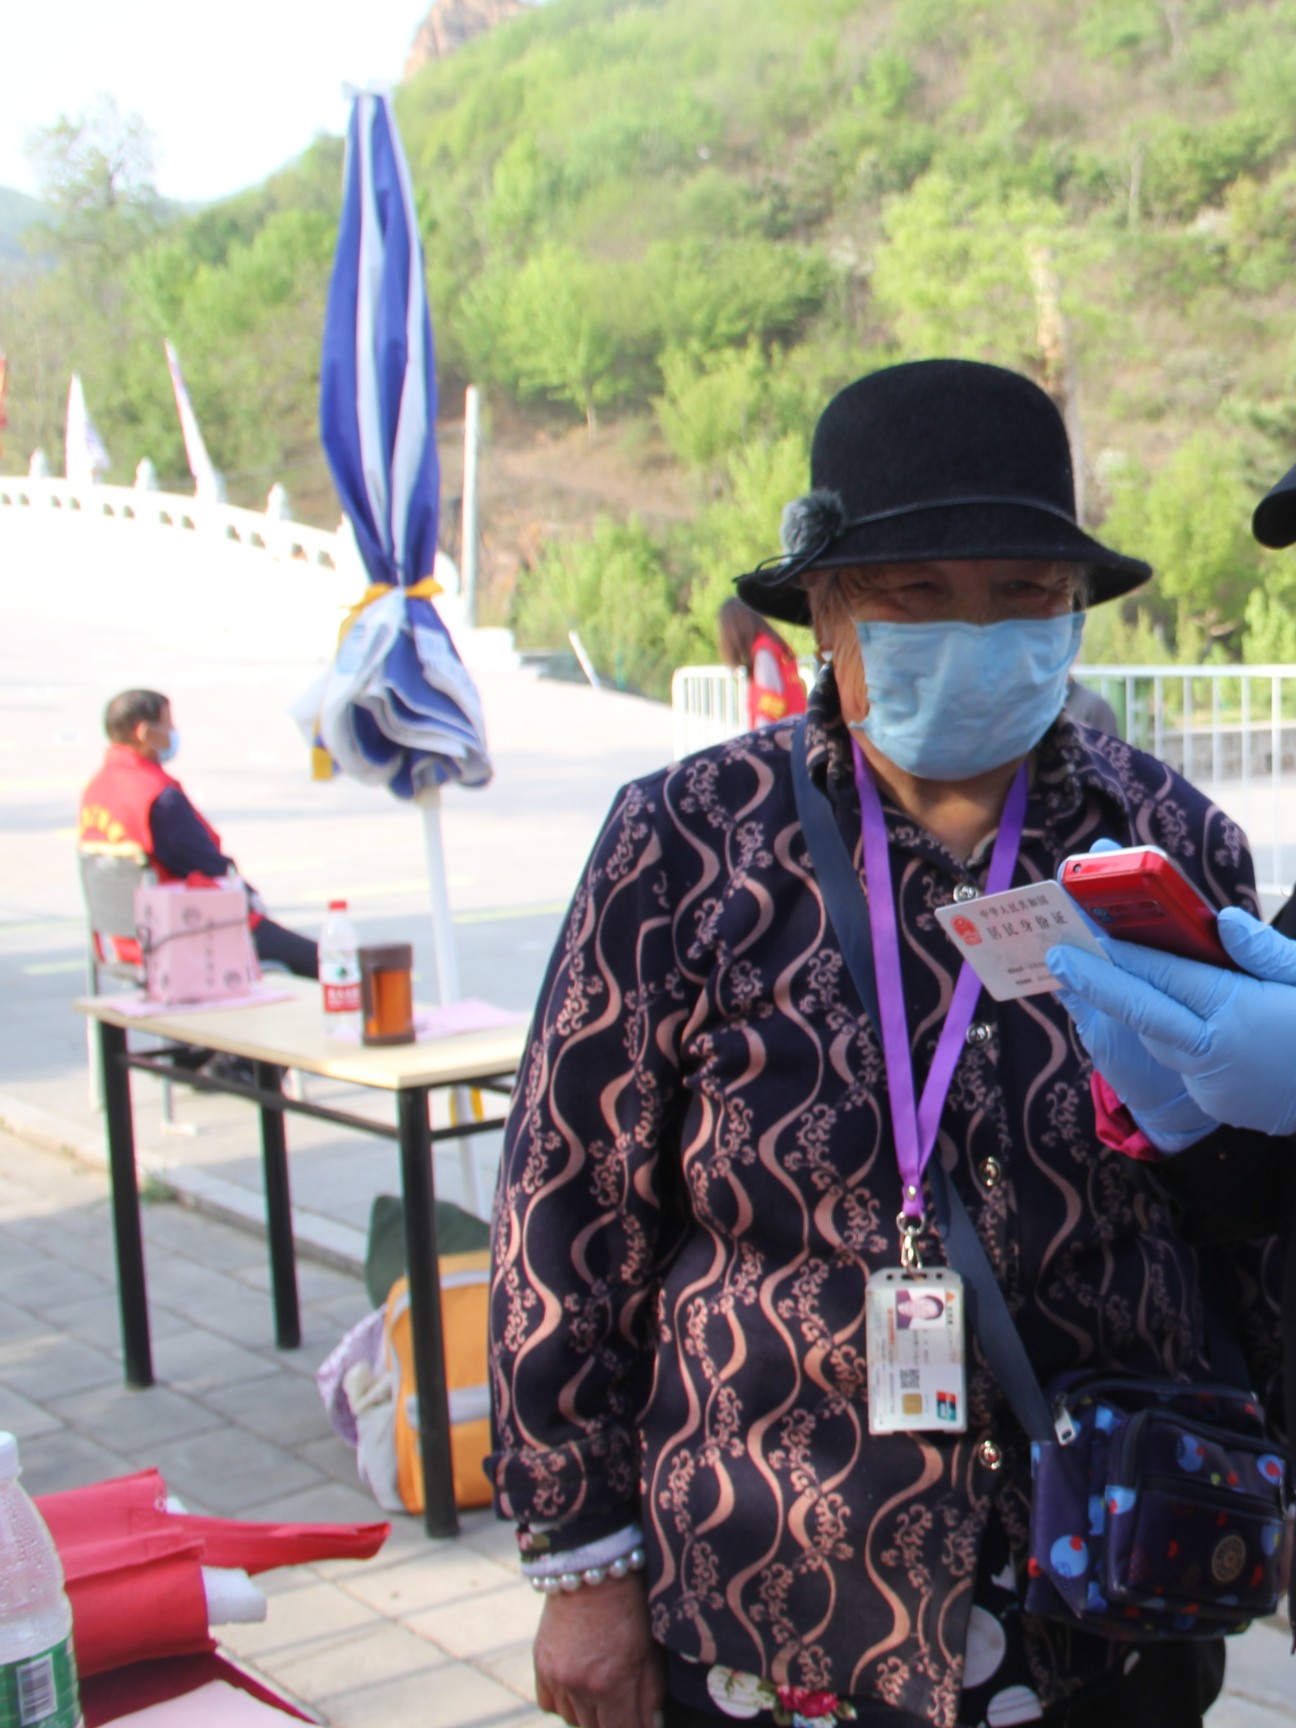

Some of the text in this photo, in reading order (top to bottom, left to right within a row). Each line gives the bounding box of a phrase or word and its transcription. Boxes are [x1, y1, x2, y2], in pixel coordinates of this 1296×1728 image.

[980, 895, 1049, 919] 中华人民共和国
[987, 911, 1068, 940] 居民身份证
